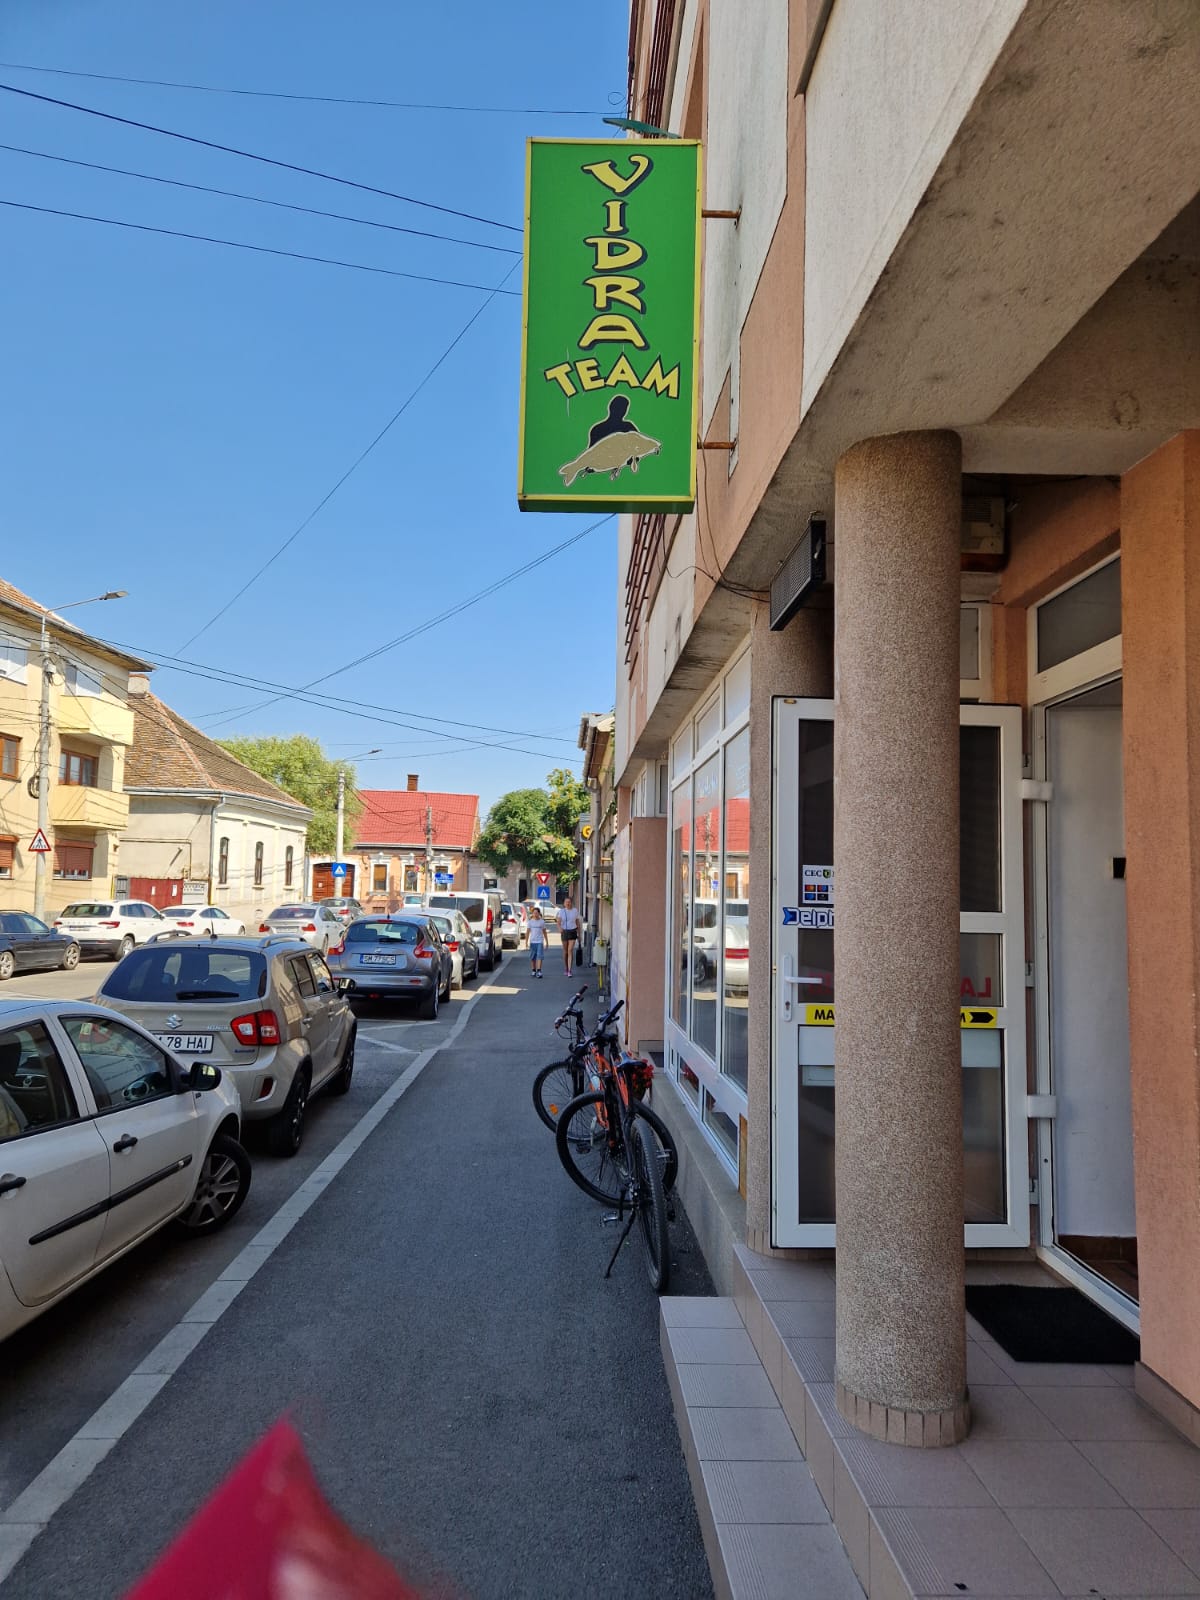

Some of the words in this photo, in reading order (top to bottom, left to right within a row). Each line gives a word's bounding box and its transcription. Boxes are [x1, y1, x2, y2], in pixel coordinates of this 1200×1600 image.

[577, 154, 655, 351] VIDRA
[544, 352, 681, 399] TEAM
[804, 869, 822, 877] CEC
[167, 1036, 182, 1049] 78
[186, 1036, 208, 1049] HAI
